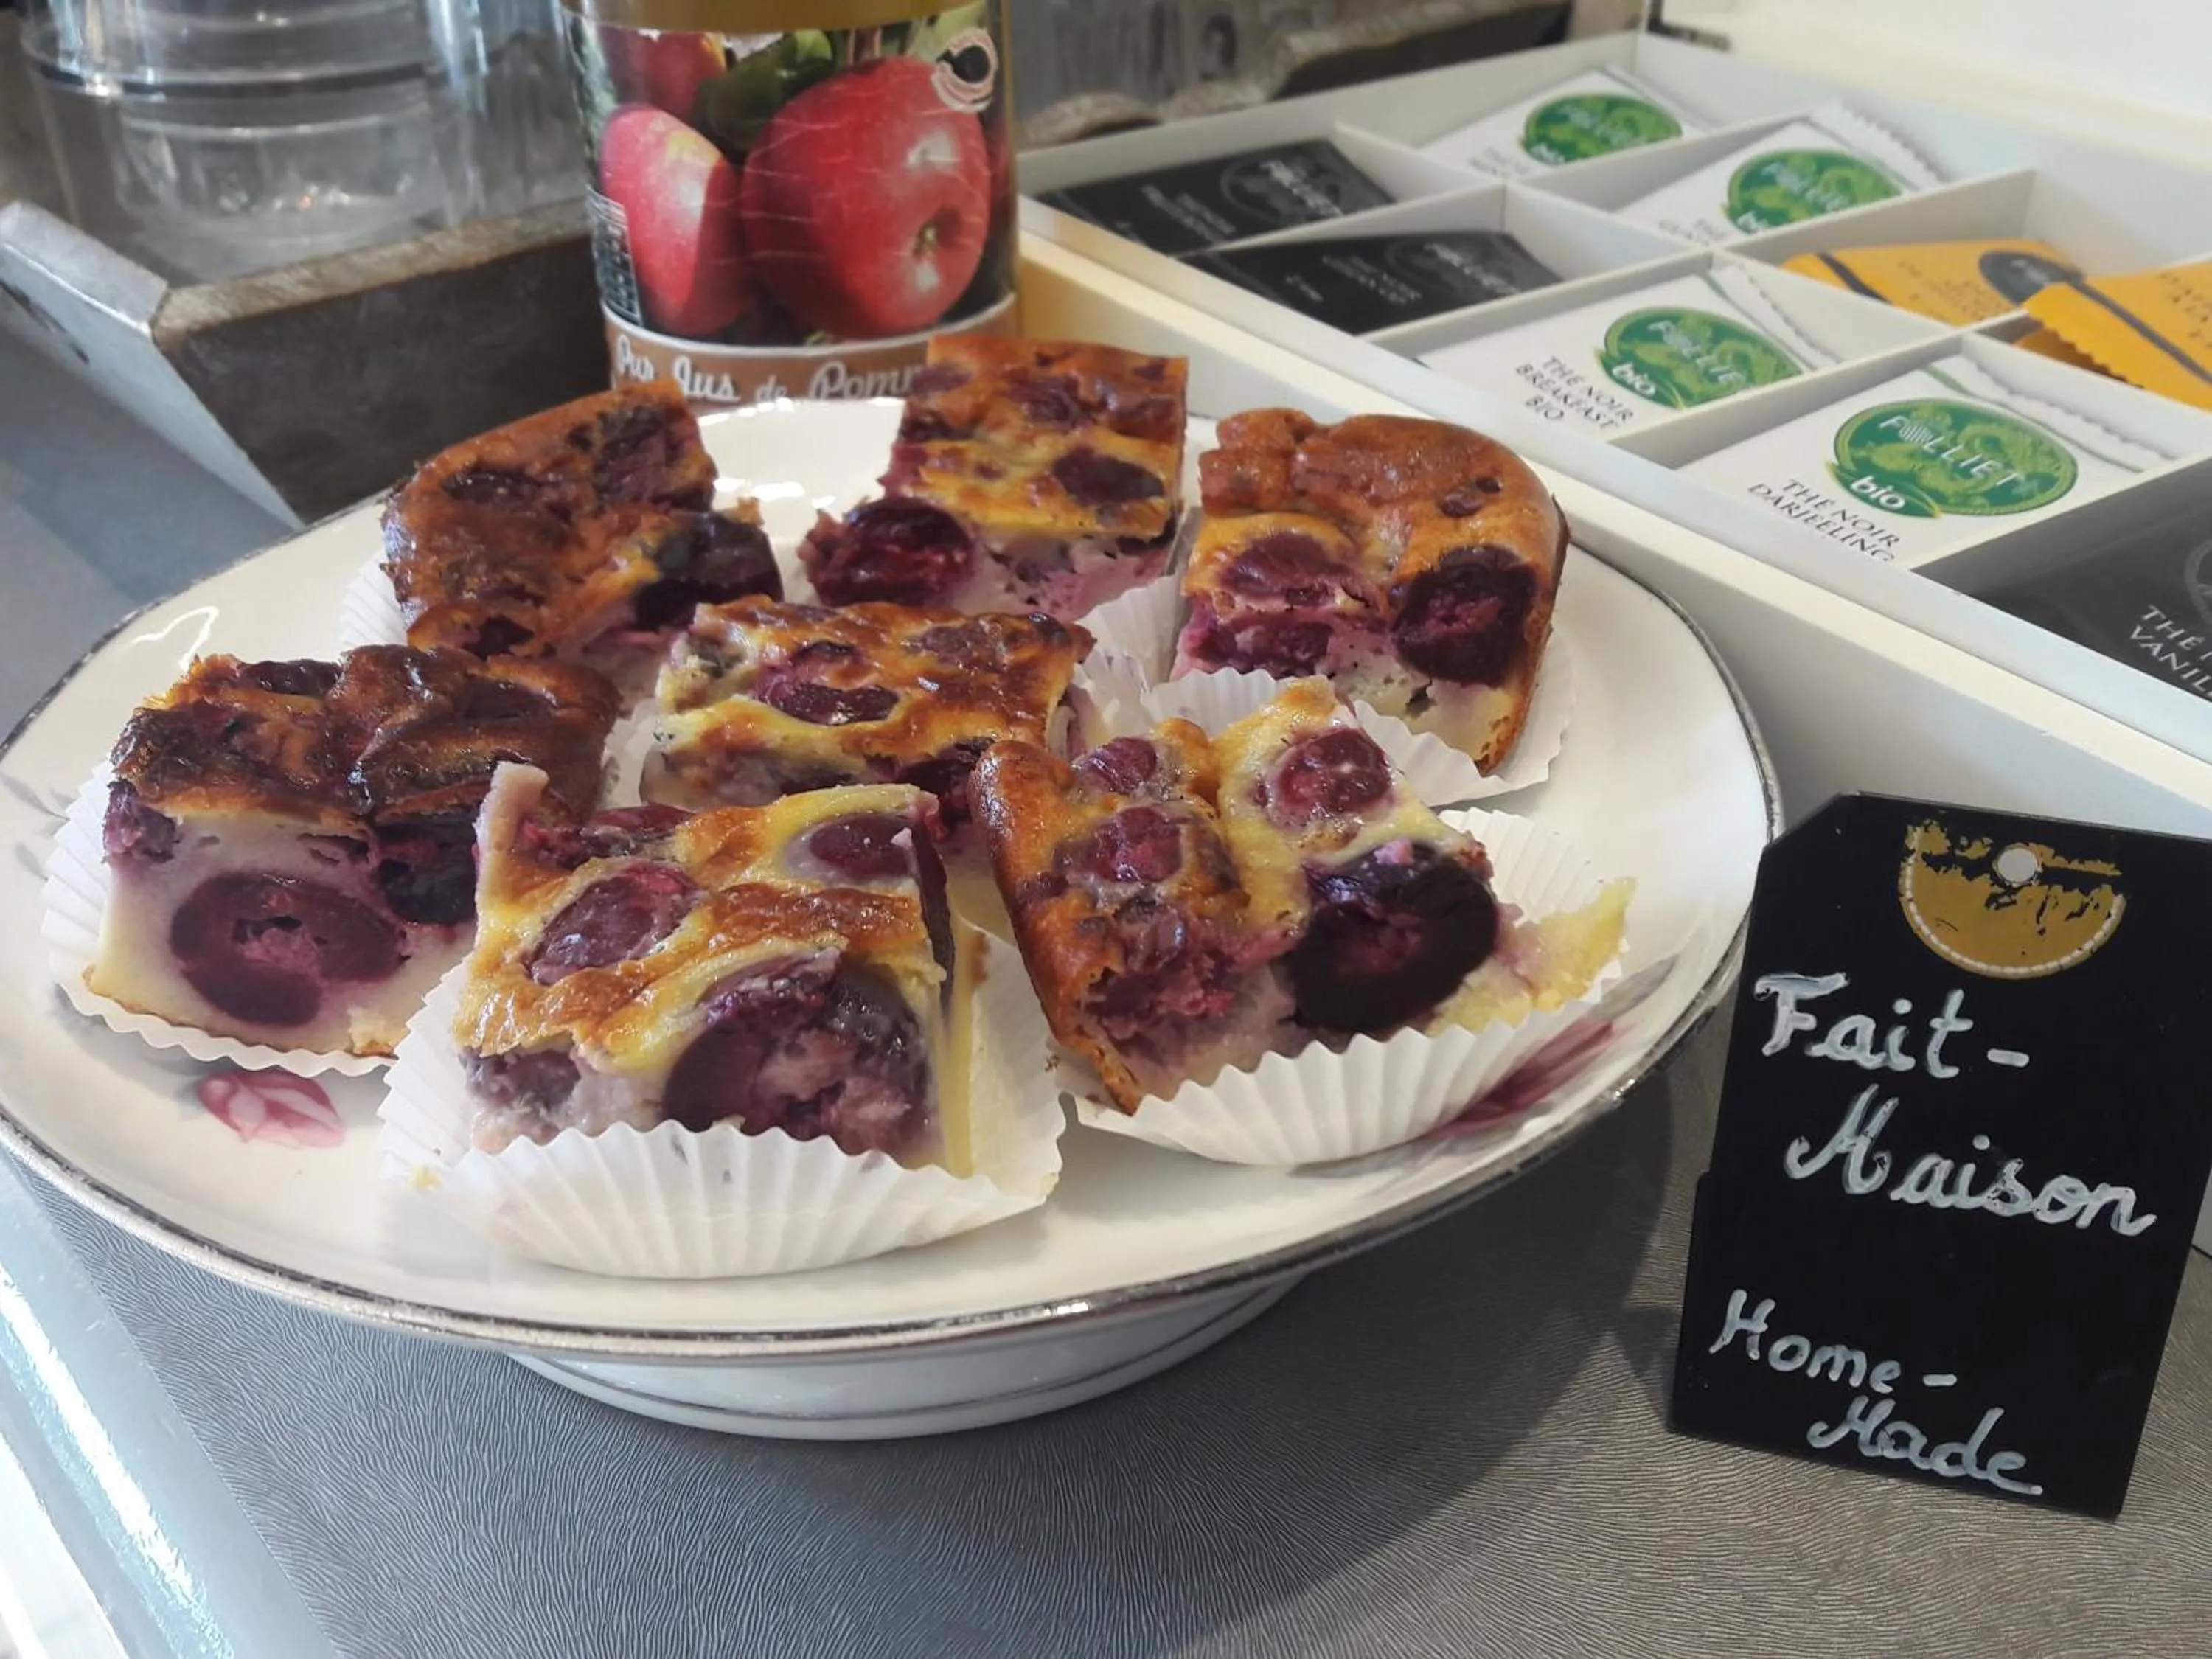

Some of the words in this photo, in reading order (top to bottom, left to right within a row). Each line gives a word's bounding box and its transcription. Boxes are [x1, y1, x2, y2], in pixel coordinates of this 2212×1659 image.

[1516, 364, 1619, 429] BREAKFAST
[1525, 395, 1565, 420] BIO
[1612, 361, 1656, 396] bio
[1747, 483, 1896, 563] DARJEELING
[1849, 474, 1906, 511] bio
[1829, 508, 1901, 549] NOIR
[2130, 625, 2212, 697] VANIL
[1785, 1085, 2157, 1237] Maison
[1807, 1396, 2043, 1495] Made
